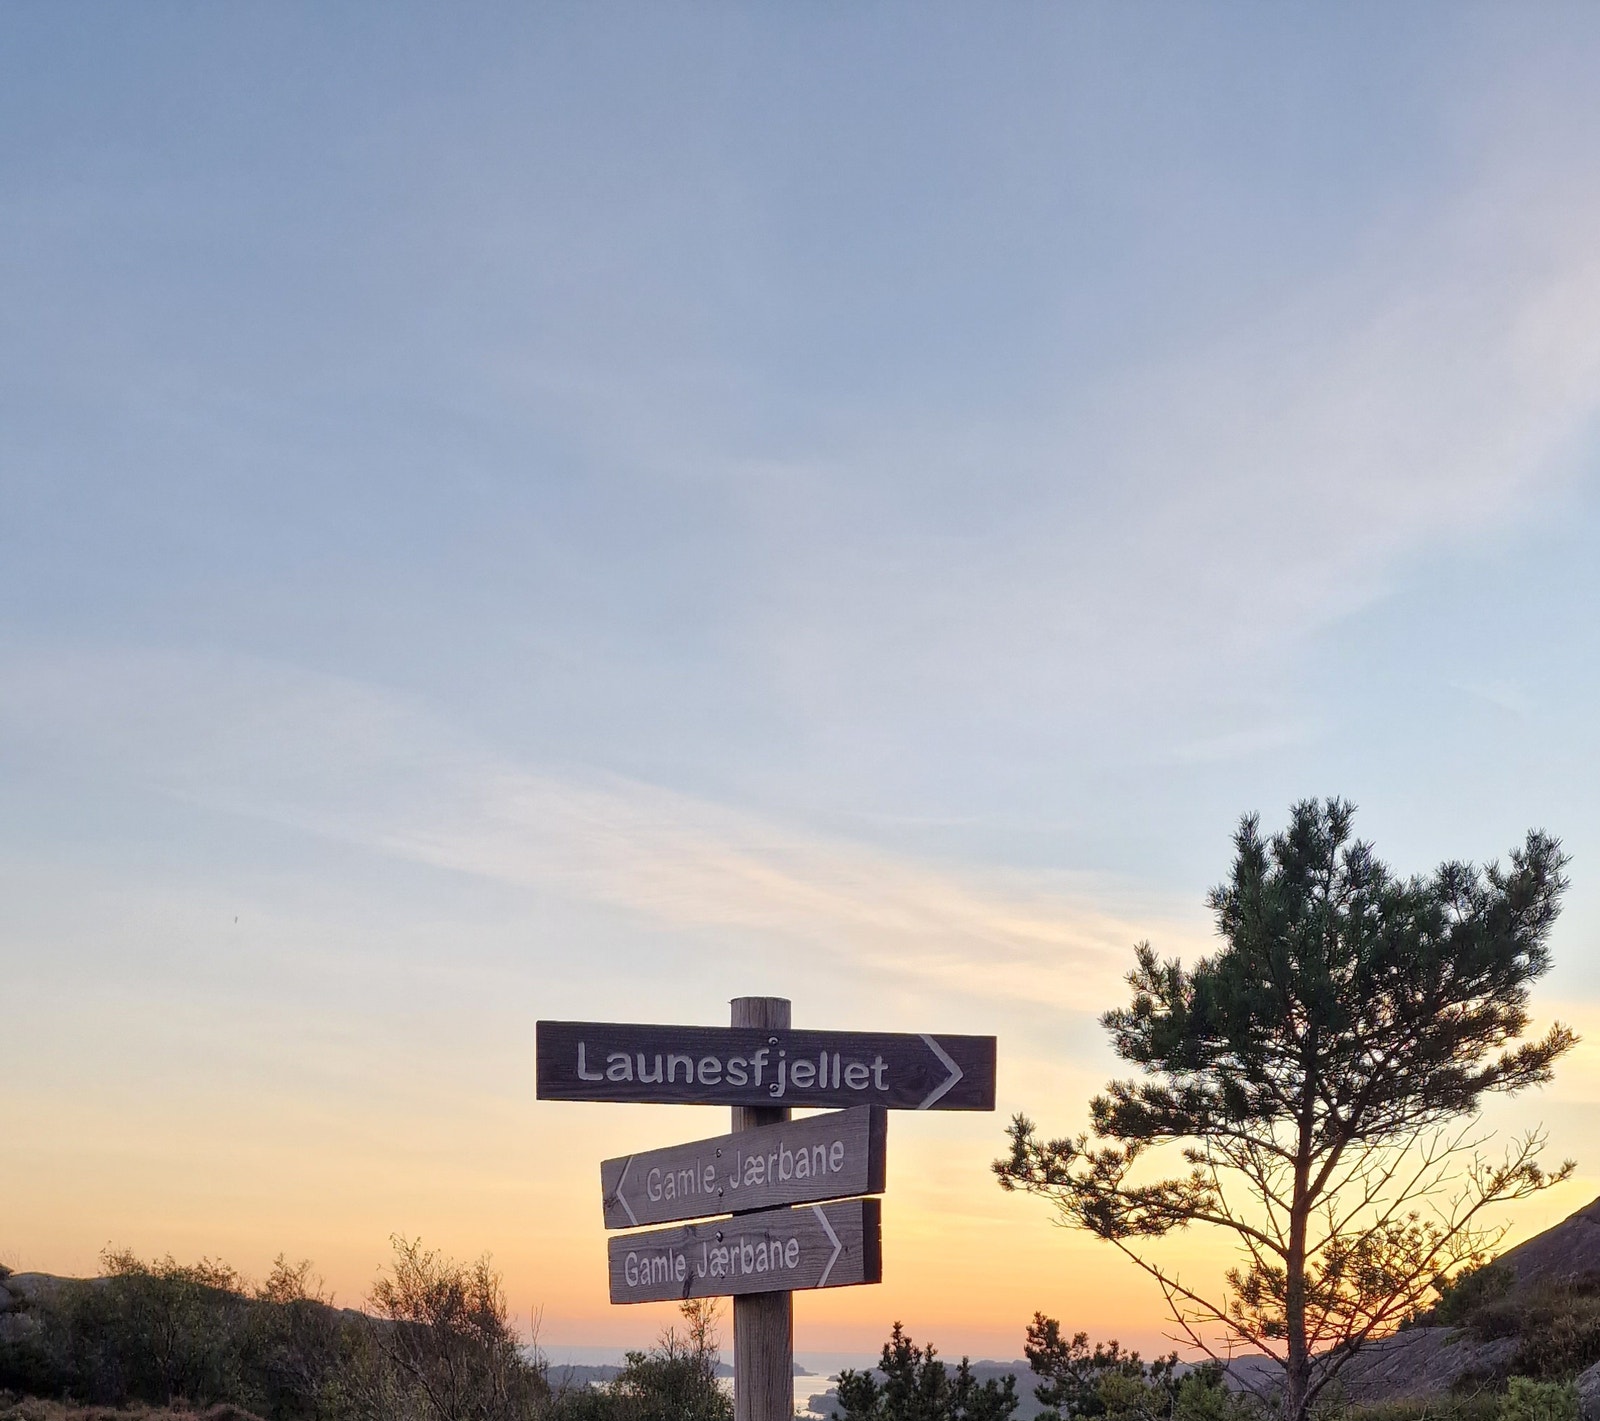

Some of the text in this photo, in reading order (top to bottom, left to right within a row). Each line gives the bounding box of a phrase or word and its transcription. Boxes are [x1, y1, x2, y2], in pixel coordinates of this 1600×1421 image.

[577, 1040, 890, 1097] Launesfjellet
[646, 1140, 845, 1202] Gamle Jærbane
[624, 1234, 800, 1287] Gamle Jærbane
